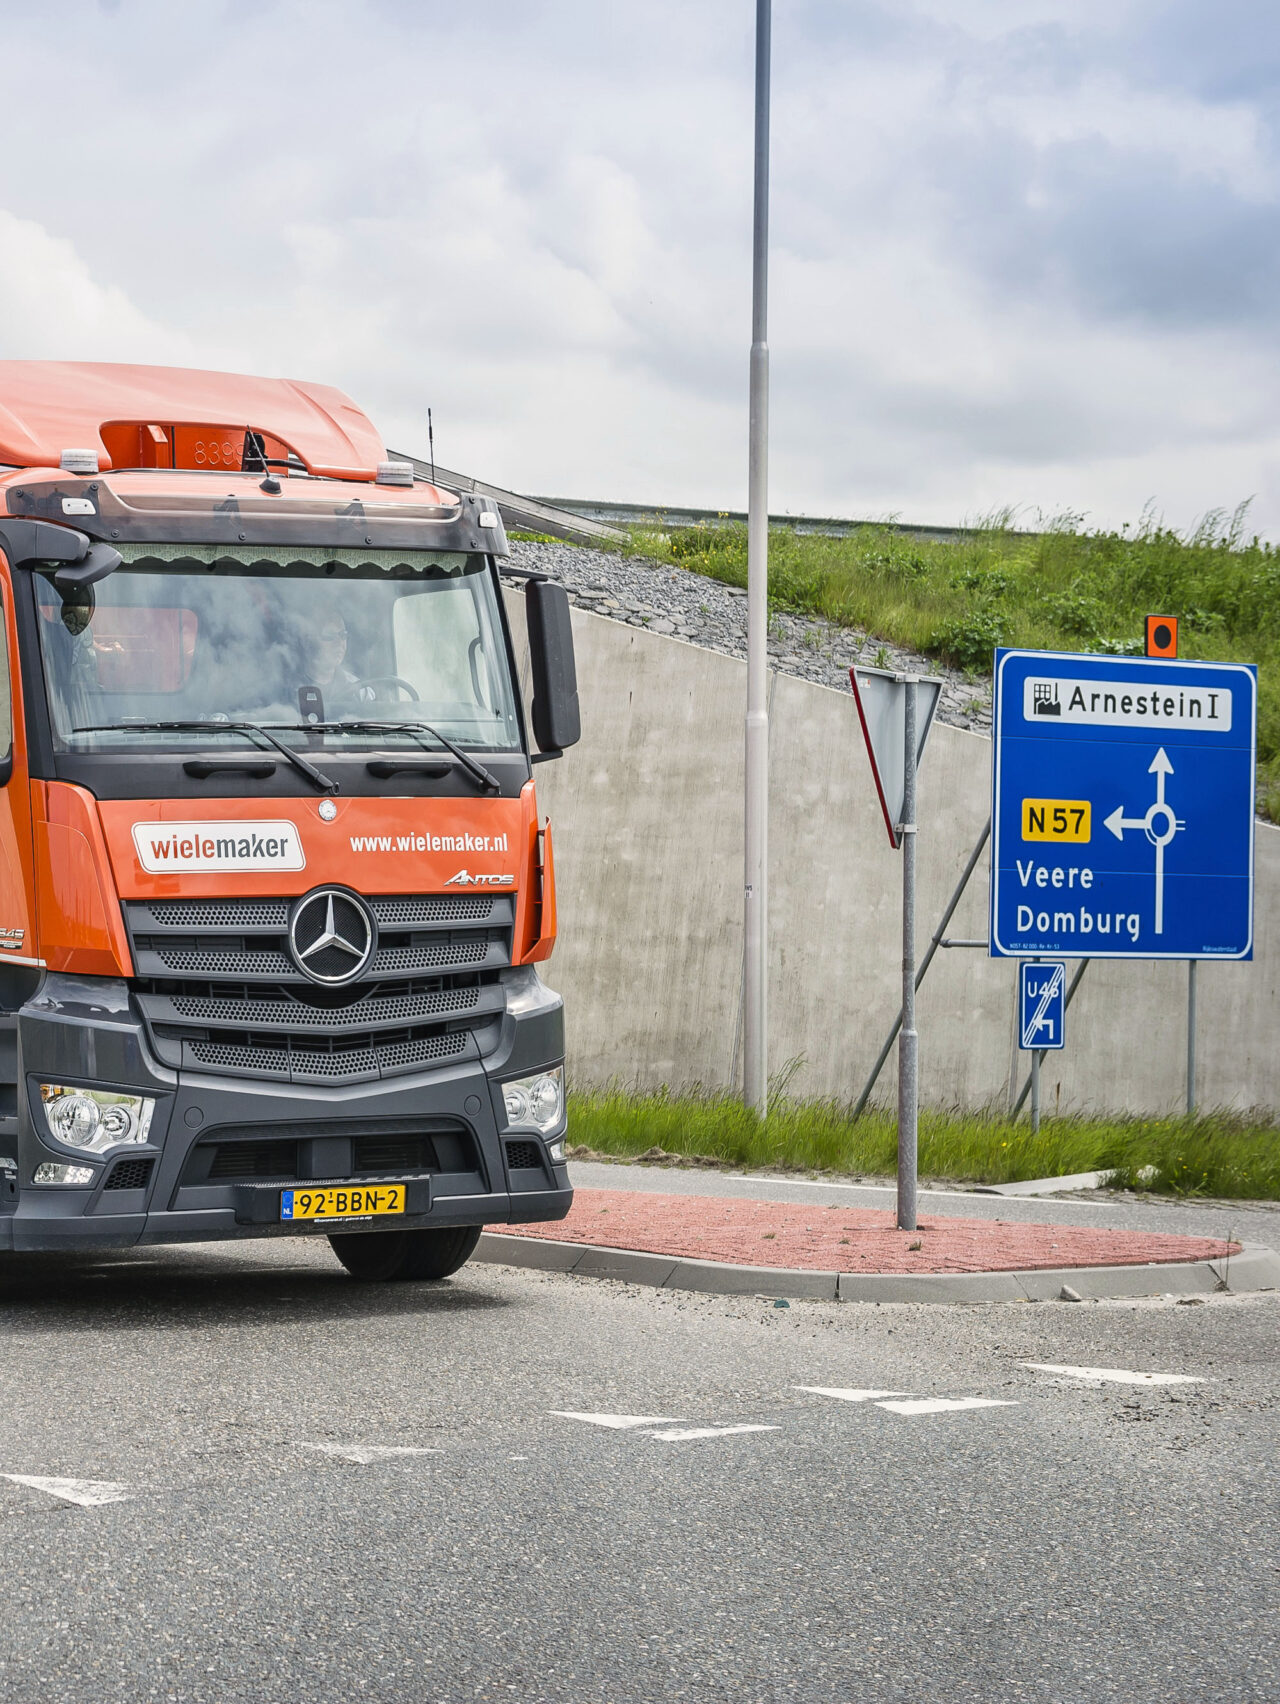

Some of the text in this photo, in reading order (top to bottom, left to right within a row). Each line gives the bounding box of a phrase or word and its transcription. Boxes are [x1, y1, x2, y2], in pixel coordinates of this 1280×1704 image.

[150, 834, 289, 860] wielemaker
[349, 832, 509, 852] www.wielemaker.nl
[1016, 860, 1094, 889] Veere
[1017, 905, 1140, 943] Domburg
[283, 1207, 292, 1215] NL
[299, 1190, 398, 1215] 92-BBN-2
